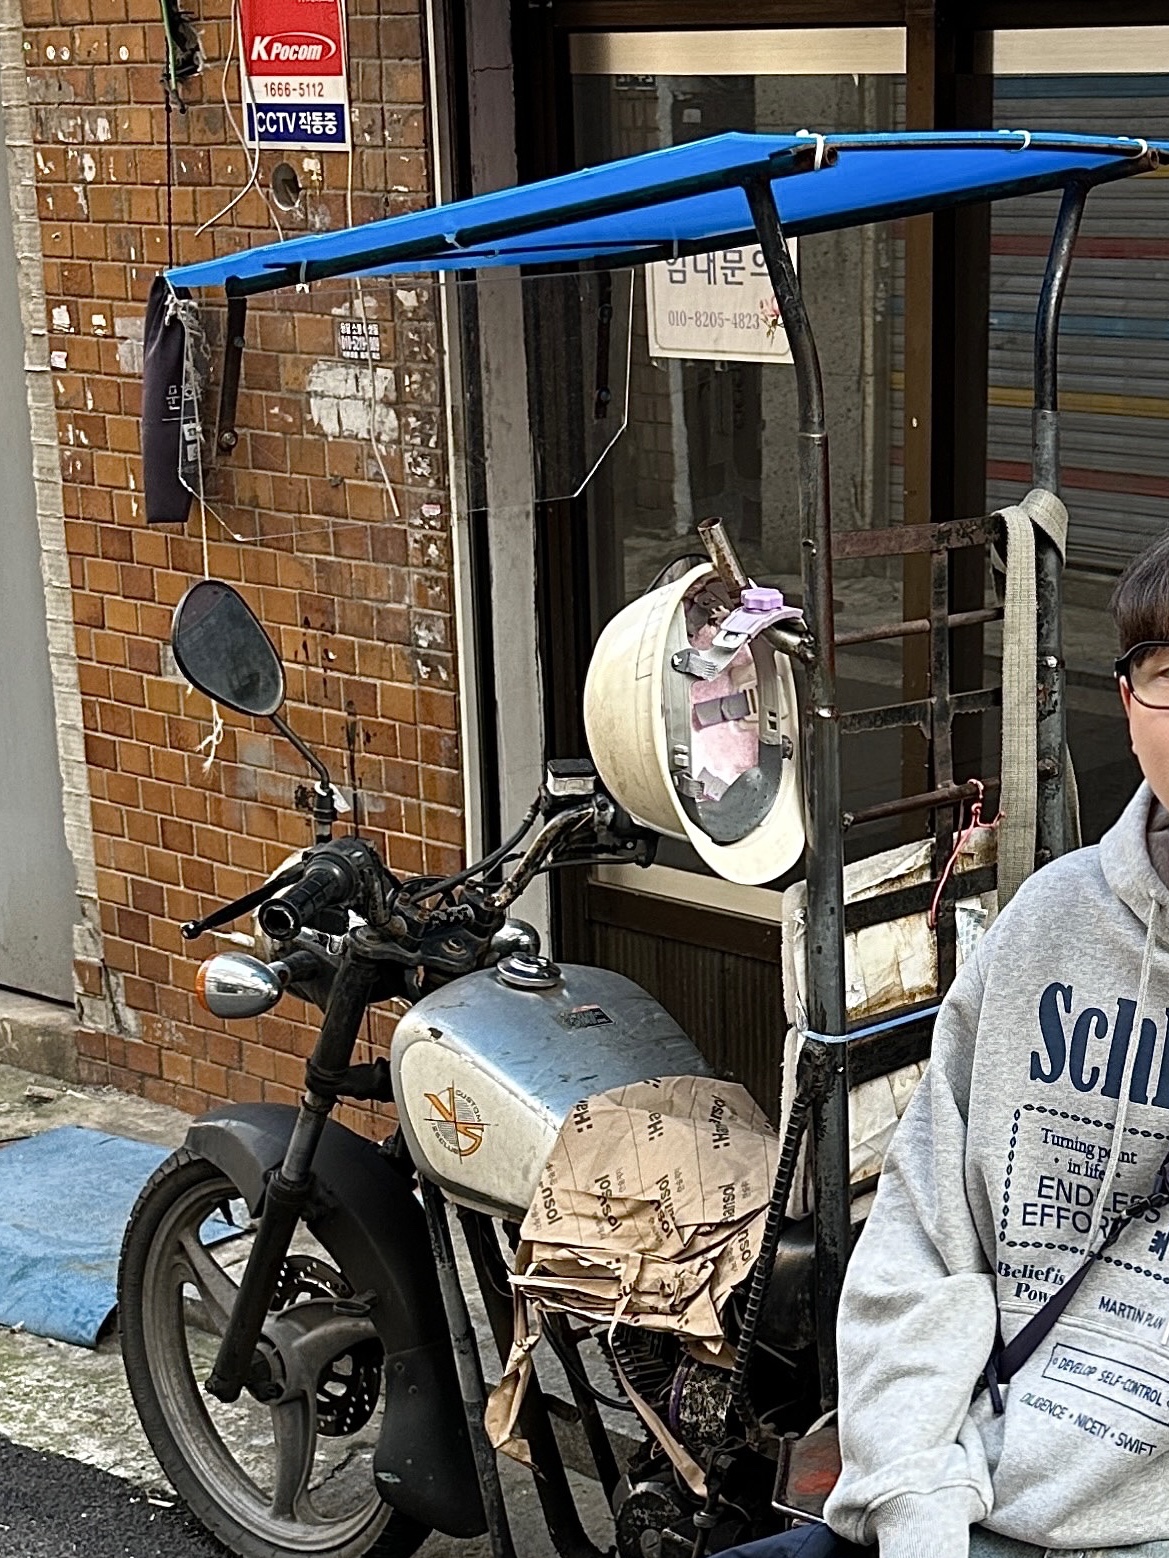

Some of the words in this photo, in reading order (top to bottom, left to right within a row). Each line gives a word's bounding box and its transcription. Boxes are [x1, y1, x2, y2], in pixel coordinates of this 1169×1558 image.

[263, 82, 324, 97] 1666-5112
[256, 112, 296, 133] CCTV
[299, 112, 338, 134] 작동중
[668, 310, 760, 329] 010-8205-4823
[455, 1089, 483, 1122] CUSTOM
[1041, 1127, 1095, 1160] Turning
[1067, 1158, 1081, 1175] in
[997, 1261, 1055, 1284] Belief
[1053, 1268, 1067, 1286] is
[1014, 1281, 1052, 1303] Pow
[1098, 1296, 1146, 1324] MARTIN
[1143, 1312, 1166, 1330] PLAN
[1057, 1357, 1098, 1377] DEVELOP
[1098, 1370, 1163, 1407] SELF-CONTROL
[1073, 1413, 1111, 1439] NICETY
[1115, 1432, 1157, 1457] SWIFT
